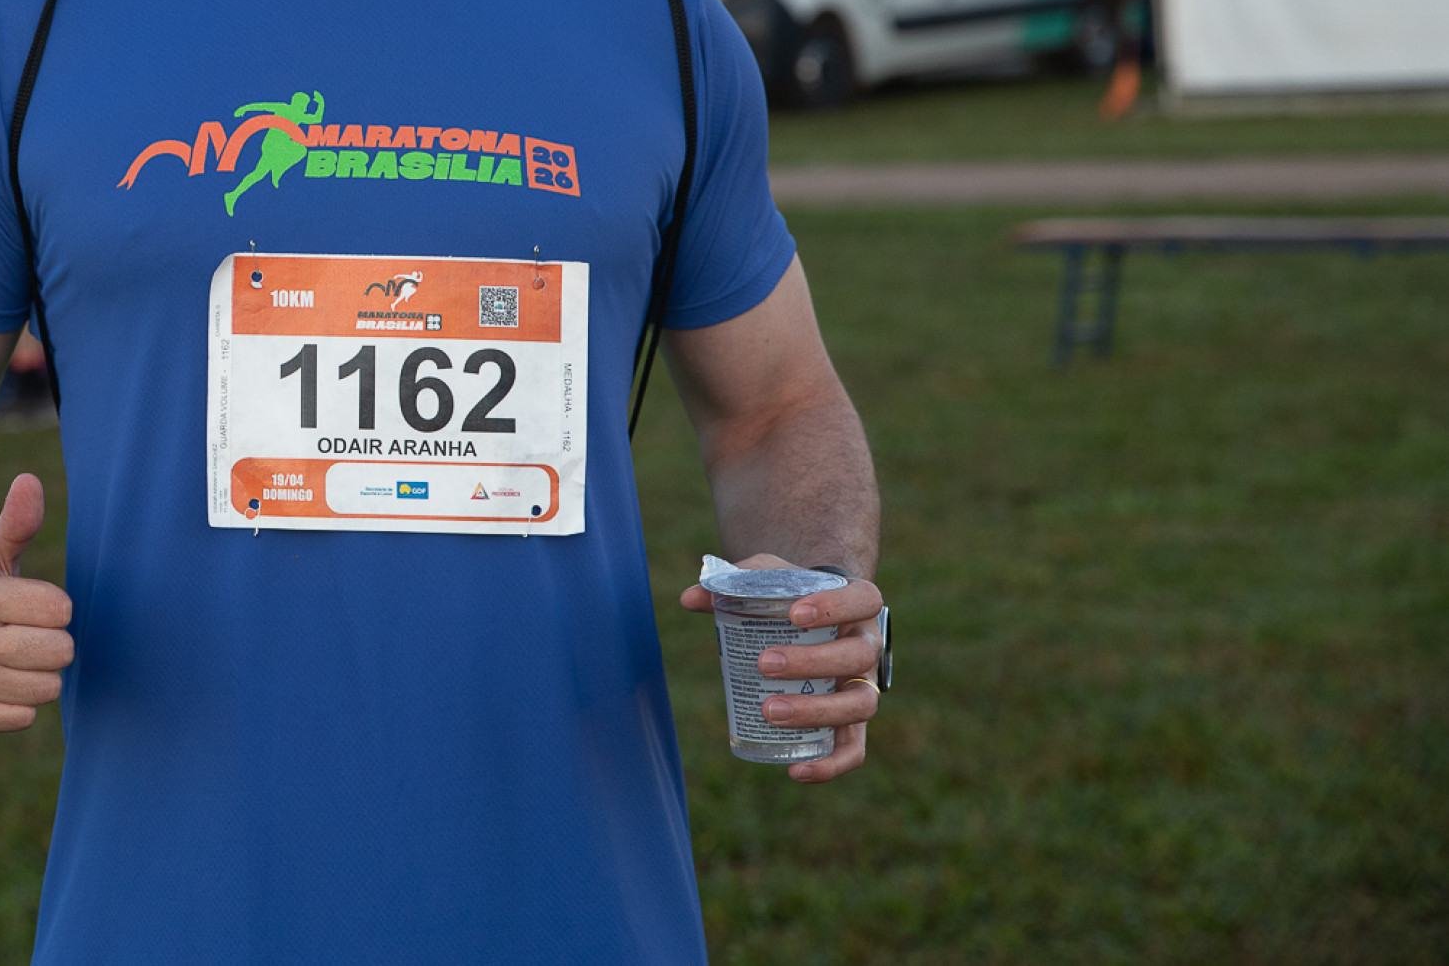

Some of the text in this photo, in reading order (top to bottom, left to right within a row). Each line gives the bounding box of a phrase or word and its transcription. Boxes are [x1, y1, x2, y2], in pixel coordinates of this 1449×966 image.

[302, 124, 521, 156] MARATONA
[532, 145, 570, 168] 20
[534, 167, 574, 189] 26
[270, 290, 314, 308] 10KM
[357, 311, 423, 319] MARATONA
[222, 339, 230, 360] 1162
[220, 376, 229, 412] VOLUME
[280, 344, 516, 434] 1162
[563, 363, 572, 413] MEDALHA
[219, 413, 228, 450] GUARDA
[562, 430, 571, 452] 1162
[317, 437, 477, 457] ODAIR ARANHA
[271, 473, 304, 486] 19/04
[262, 488, 313, 502] DOMINGO
